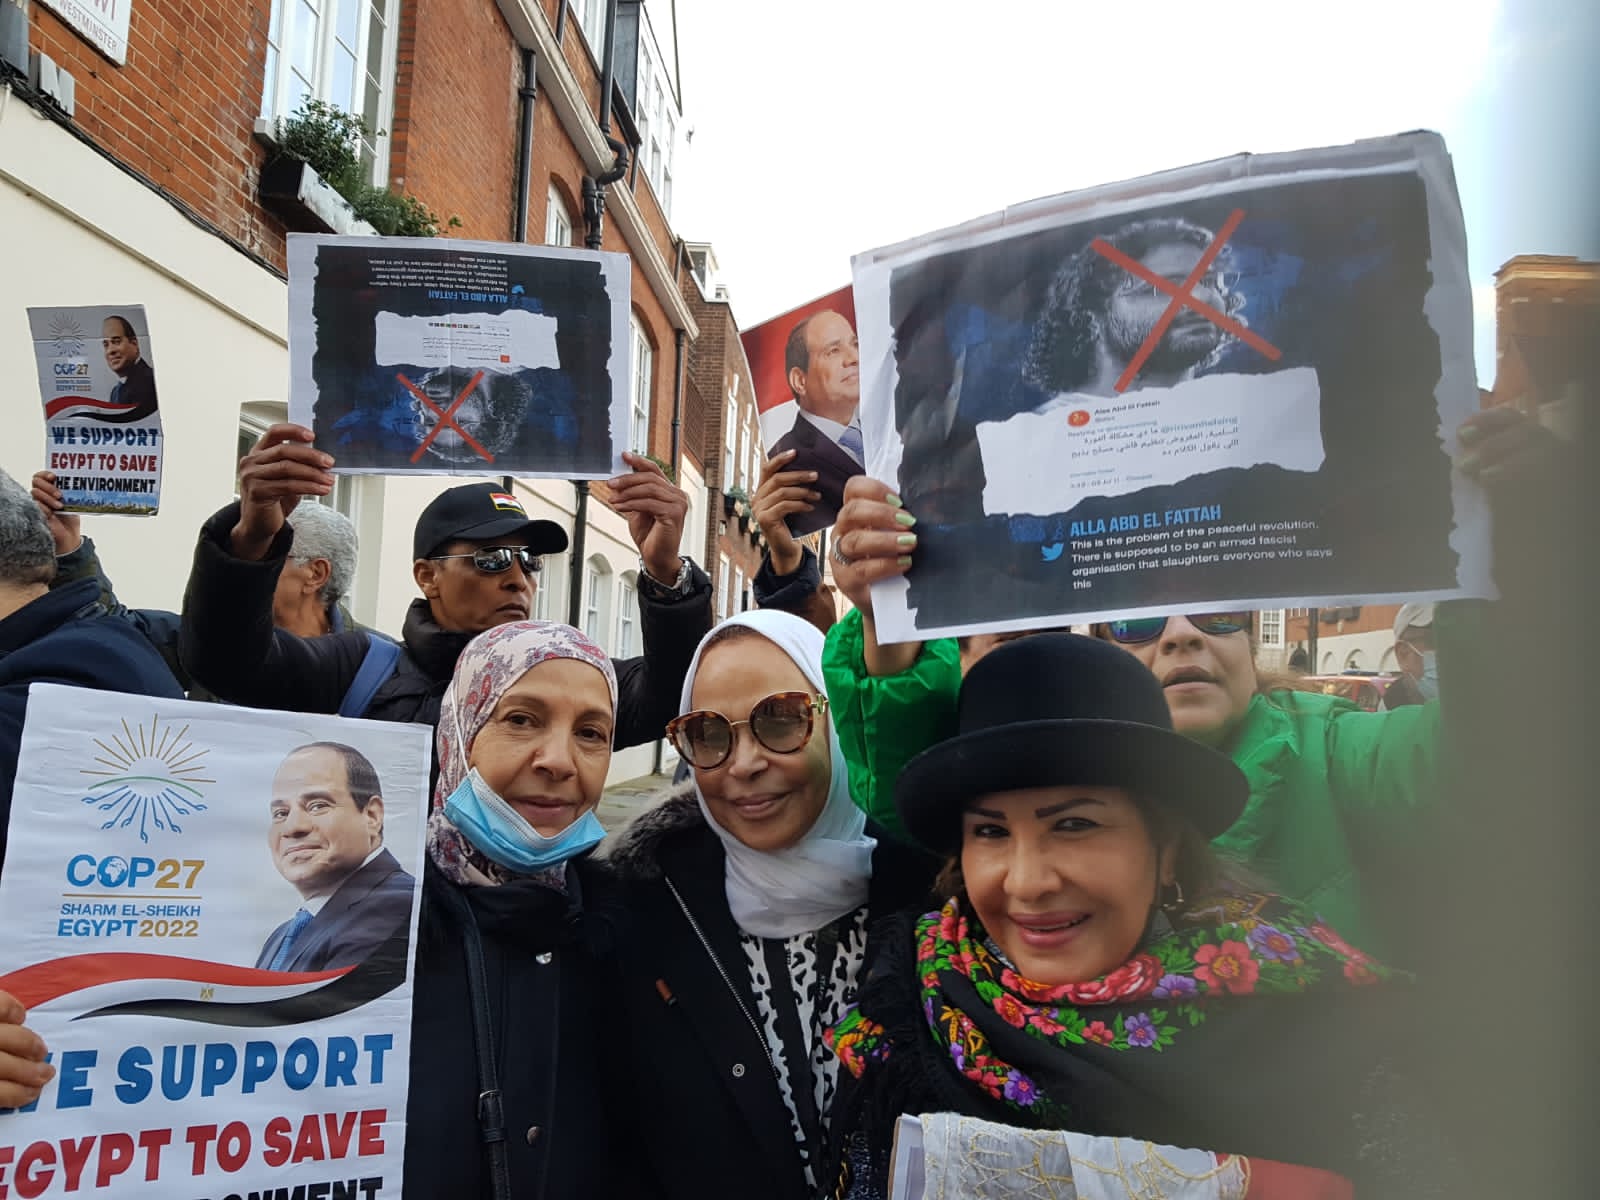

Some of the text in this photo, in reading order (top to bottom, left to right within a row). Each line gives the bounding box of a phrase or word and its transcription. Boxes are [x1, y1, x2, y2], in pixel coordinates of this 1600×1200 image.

[60, 0, 117, 54] WESTMINSTER
[53, 363, 89, 375] COP27
[52, 426, 158, 446] WE SUPPORT
[51, 452, 157, 472] EGYPT TO SAVE
[72, 476, 156, 493] ENVIRONMENT
[1070, 504, 1221, 537] ALLA ABD EL FATTAH
[1071, 540, 1092, 550] This
[1095, 539, 1104, 547] is
[1106, 536, 1122, 546] the
[1126, 532, 1170, 546] problem
[1173, 530, 1184, 539] of
[1187, 527, 1205, 537] the
[1207, 523, 1256, 537] peaceful
[1072, 534, 1297, 563] There is supposed to be an armed fascist
[1072, 547, 1333, 577] organisation that slaughters everyone who says
[1073, 580, 1092, 590] this
[66, 854, 205, 889] COP27
[60, 903, 201, 917] SHARM EL-SHEIKH
[57, 918, 199, 937] EGYPT 2022
[114, 1034, 393, 1104] SUPPORT
[186, 1121, 252, 1176] TO
[263, 1108, 387, 1167] SAVE
